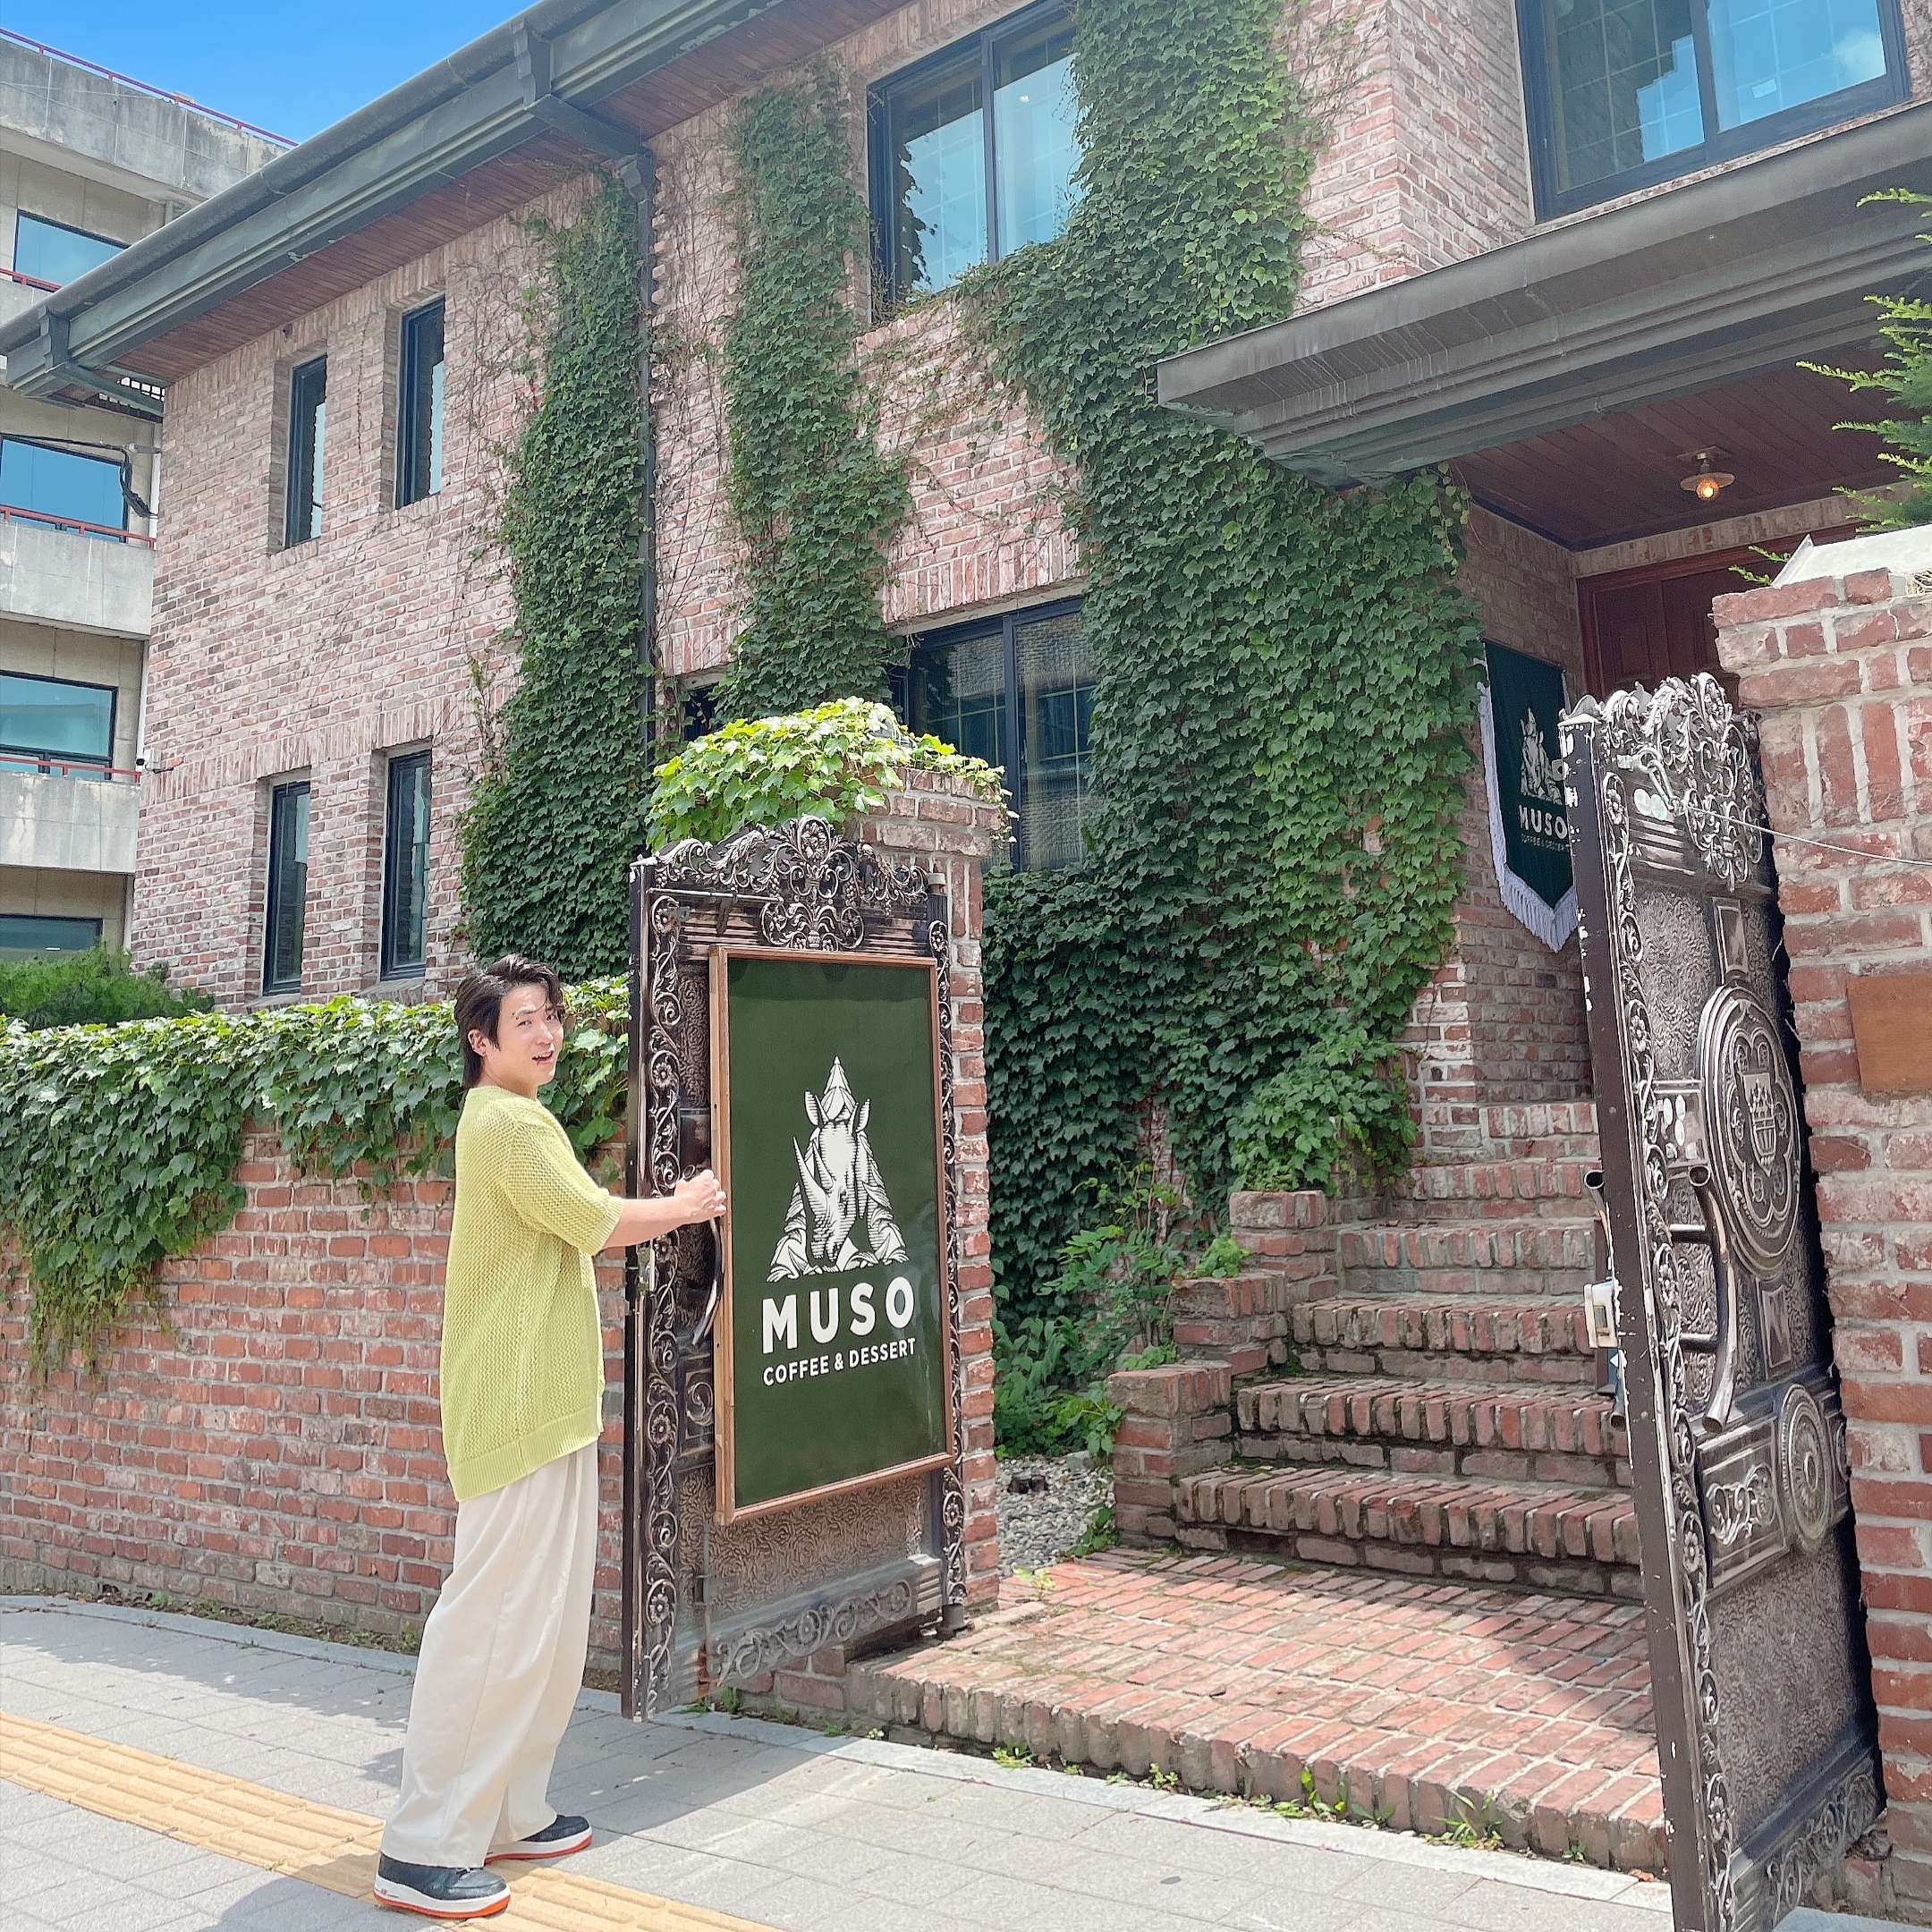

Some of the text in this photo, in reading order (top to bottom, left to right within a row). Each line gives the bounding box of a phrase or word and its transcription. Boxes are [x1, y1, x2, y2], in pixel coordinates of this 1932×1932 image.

[1519, 804, 1568, 839] MUSO
[762, 1276, 914, 1354] MUSO
[762, 1337, 916, 1386] COFFEE & DESSERT
